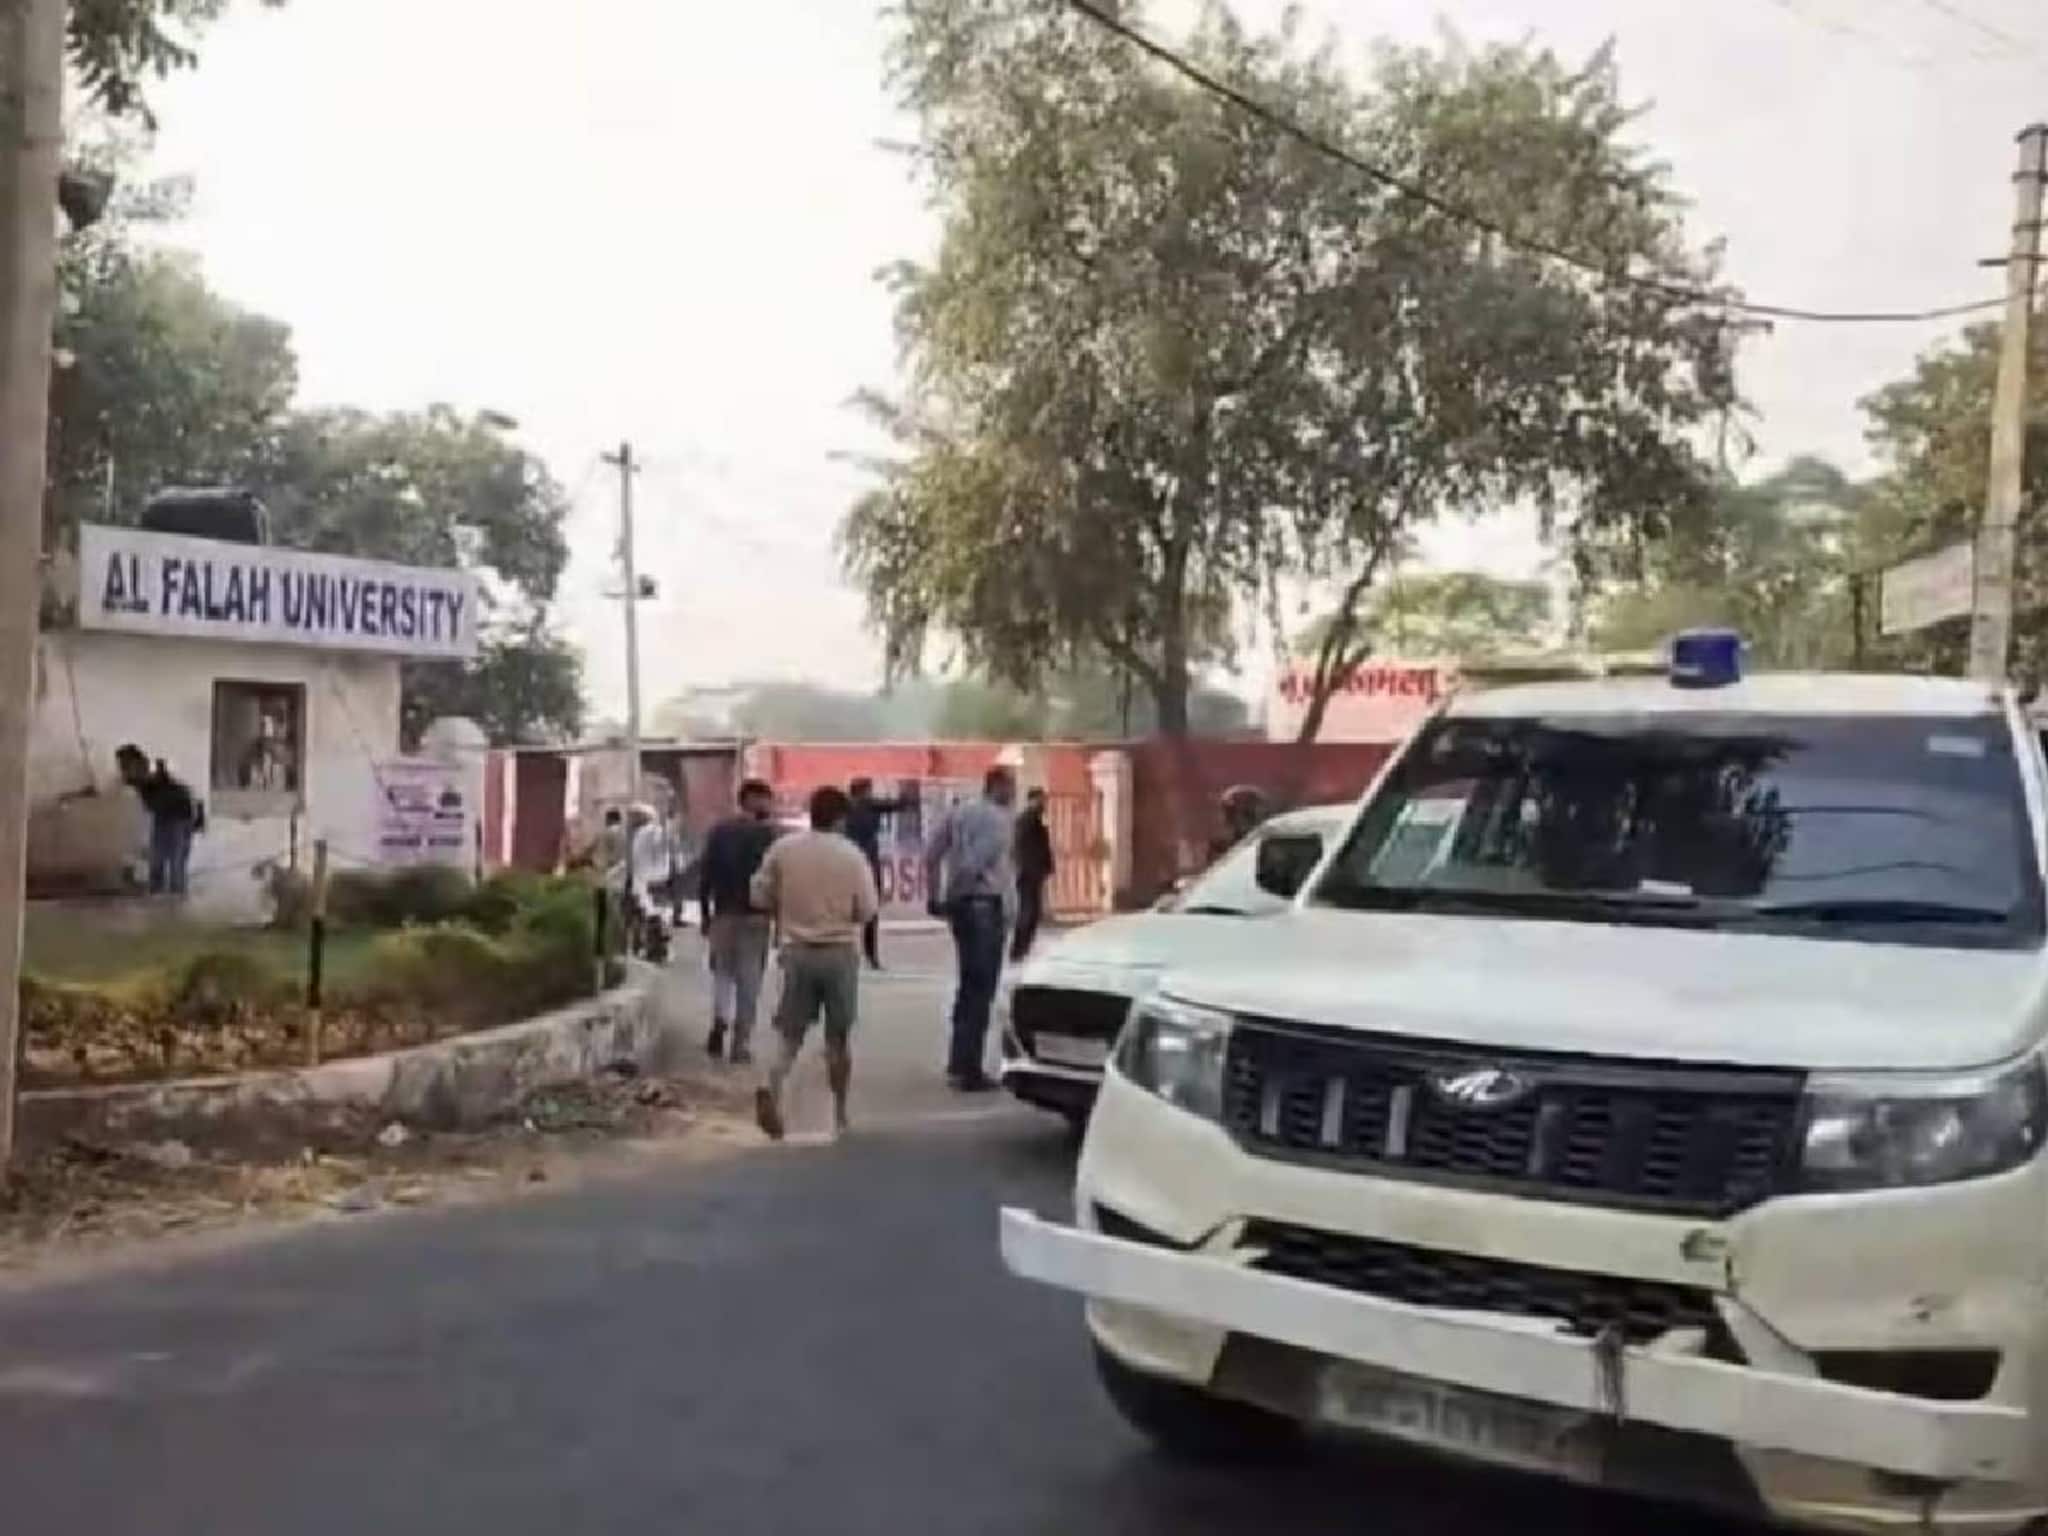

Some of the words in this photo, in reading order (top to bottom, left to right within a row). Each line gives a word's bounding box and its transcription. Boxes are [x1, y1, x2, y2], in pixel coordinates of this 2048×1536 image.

[103, 552, 149, 613] AL
[160, 558, 271, 624] FALAH
[280, 570, 464, 642] UNIVERSITY
